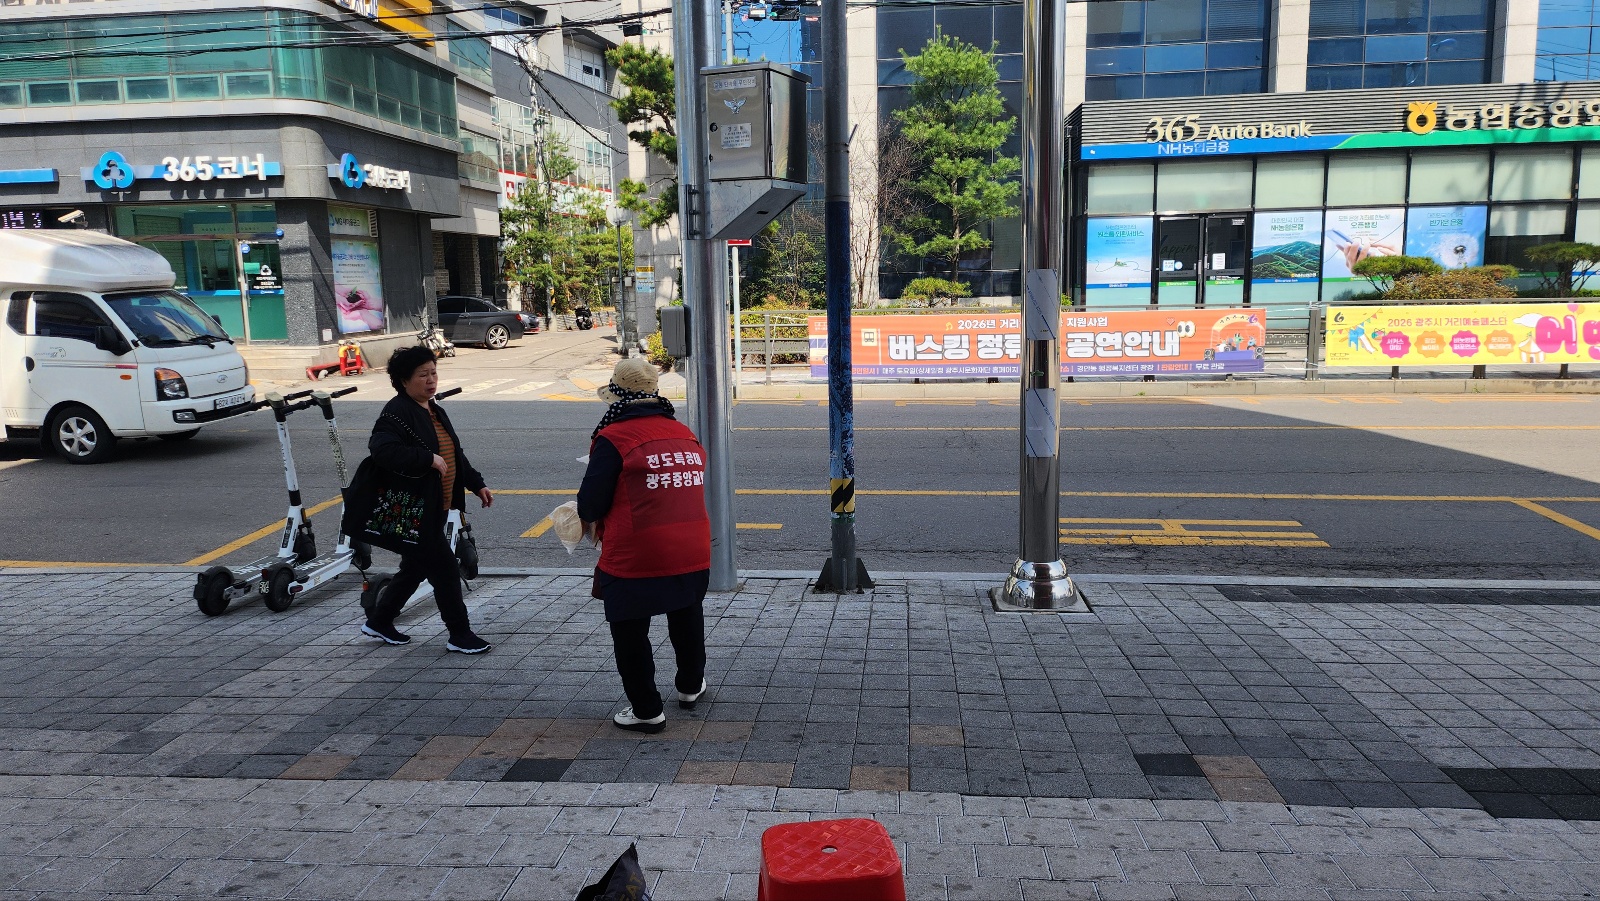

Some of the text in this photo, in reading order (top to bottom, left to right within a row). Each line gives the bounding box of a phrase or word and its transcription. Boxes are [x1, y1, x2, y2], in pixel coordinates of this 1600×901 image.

[1146, 113, 1313, 143] 365 Auto Bank
[1158, 141, 1230, 154] NH농협금융
[162, 153, 267, 181] 365코너
[958, 318, 998, 330] 2026년
[1000, 318, 1021, 330] 거리
[1067, 316, 1108, 328] 지원사업
[1388, 316, 1507, 327] 2026 광주시 거리예술페스타
[888, 330, 1180, 360] 버스킹 정류 공연안내
[646, 471, 705, 489] 광주중앙교
